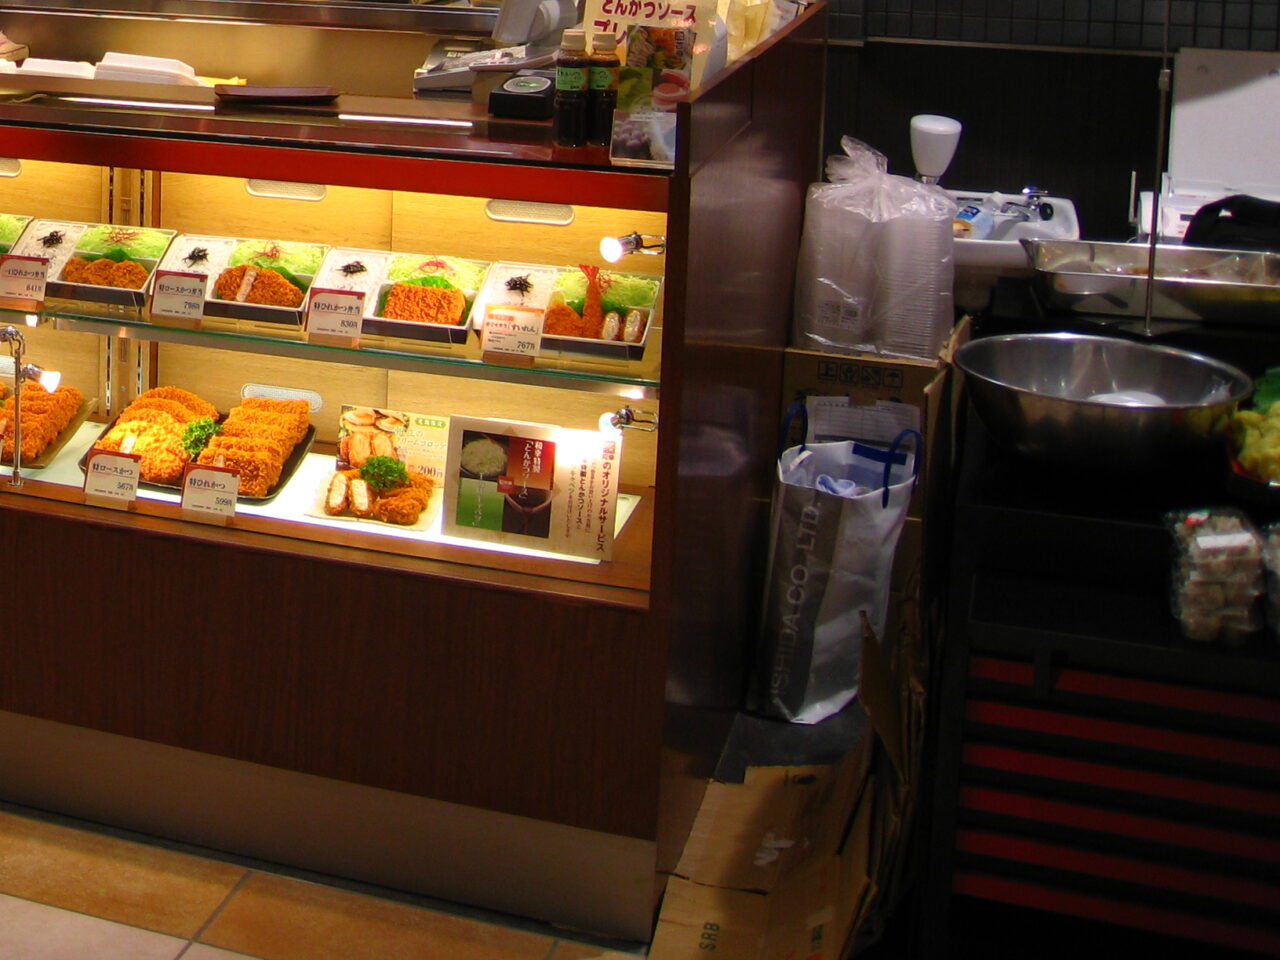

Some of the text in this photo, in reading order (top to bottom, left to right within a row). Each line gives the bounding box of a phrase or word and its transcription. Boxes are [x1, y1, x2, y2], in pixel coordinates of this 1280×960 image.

[92, 462, 134, 476] 特ロースかつ
[189, 477, 226, 490] 特ひれかつ
[699, 922, 720, 951] SRB
